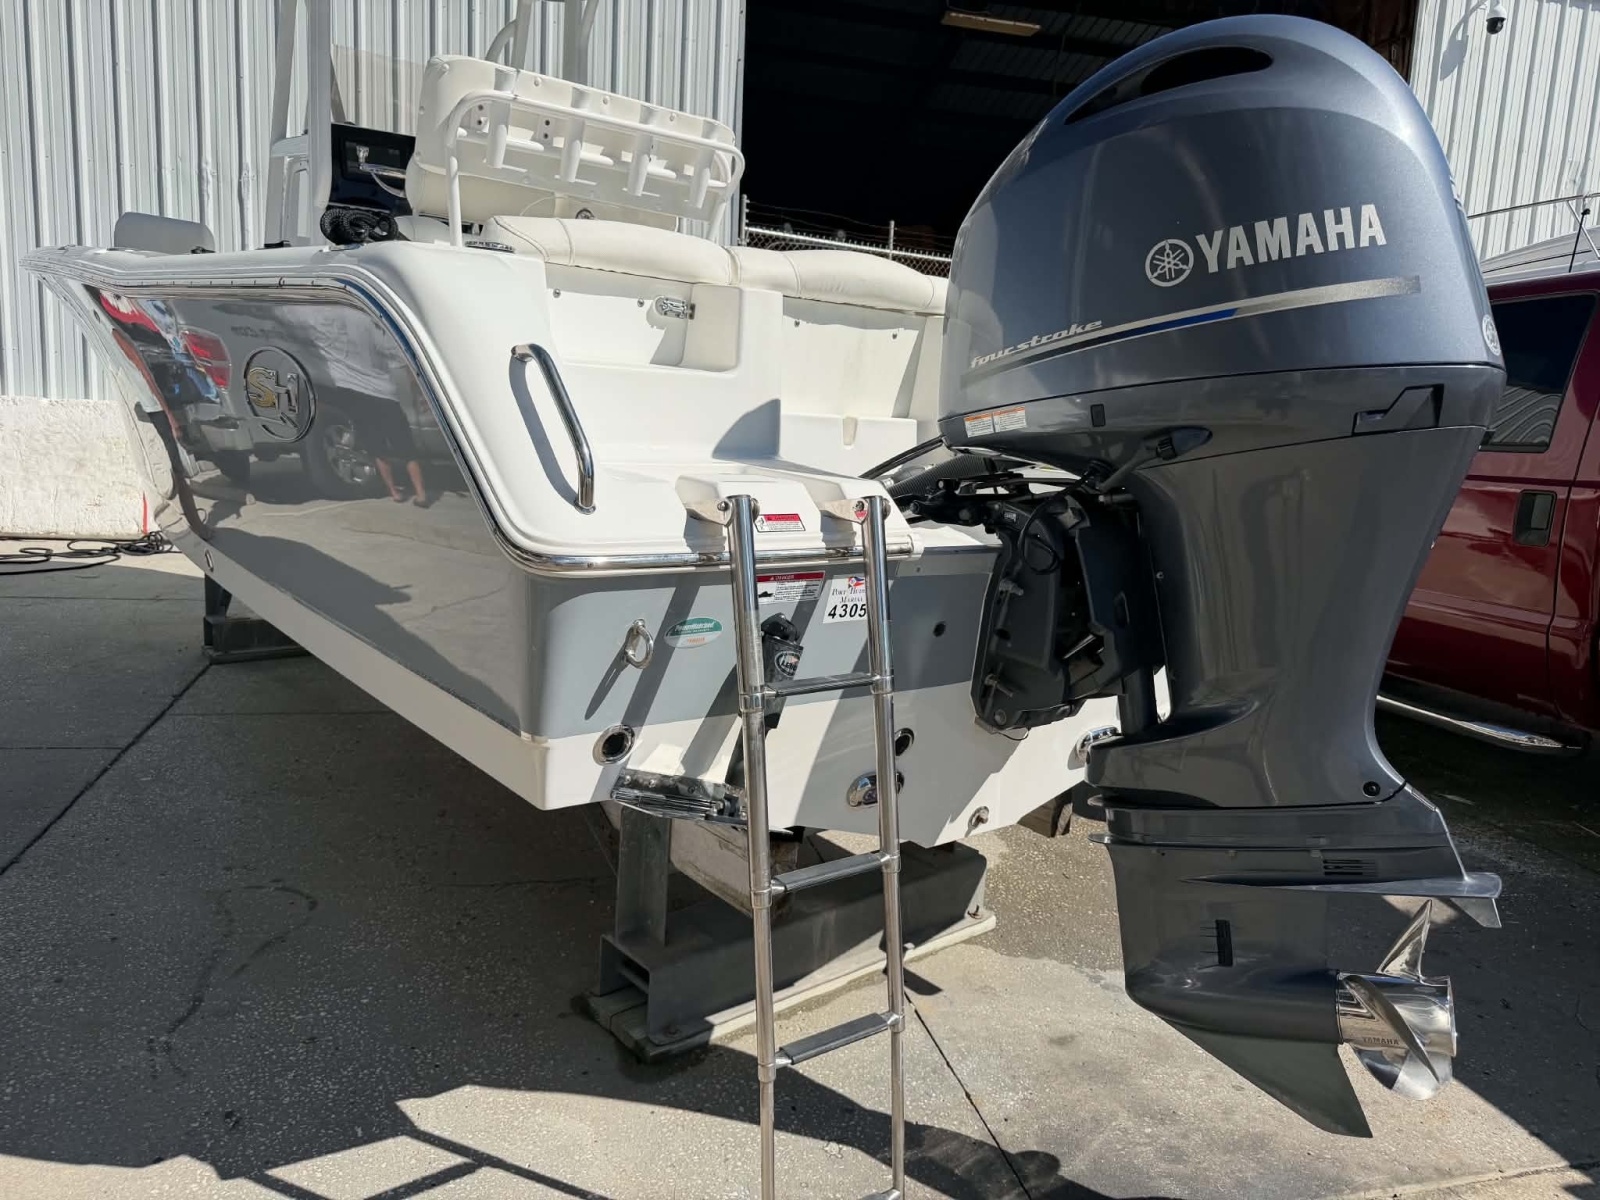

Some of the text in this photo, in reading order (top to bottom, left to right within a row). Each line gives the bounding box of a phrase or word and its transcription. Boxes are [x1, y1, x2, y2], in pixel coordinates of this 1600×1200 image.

[1195, 203, 1387, 274] YAMAHA
[828, 603, 867, 619] 4305
[1362, 1036, 1400, 1045] YAMAHA
